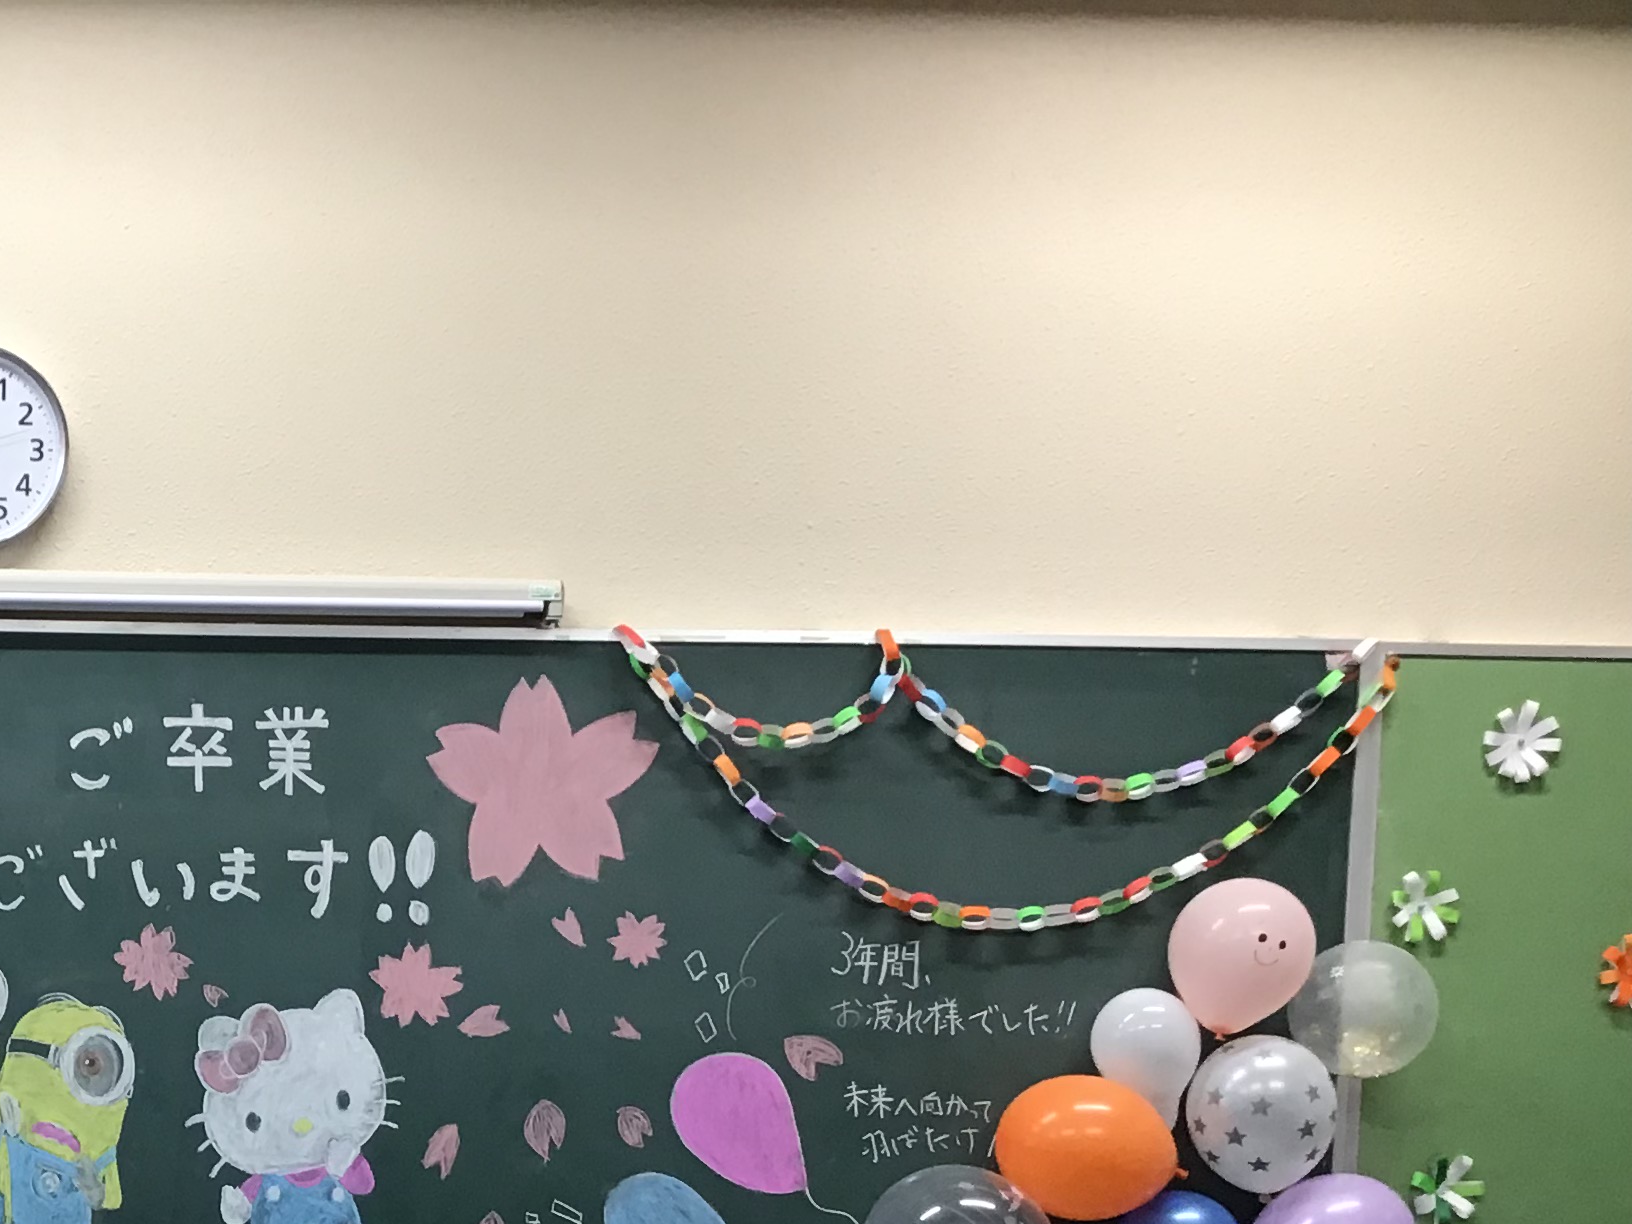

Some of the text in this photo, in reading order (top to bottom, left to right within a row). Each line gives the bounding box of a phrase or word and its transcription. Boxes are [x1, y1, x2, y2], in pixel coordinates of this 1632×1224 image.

[18, 402, 33, 426] 2
[29, 438, 44, 462] 3
[15, 473, 32, 496] 4
[70, 702, 330, 796] ご卒業
[843, 1080, 992, 1123] 未来へ向かって
